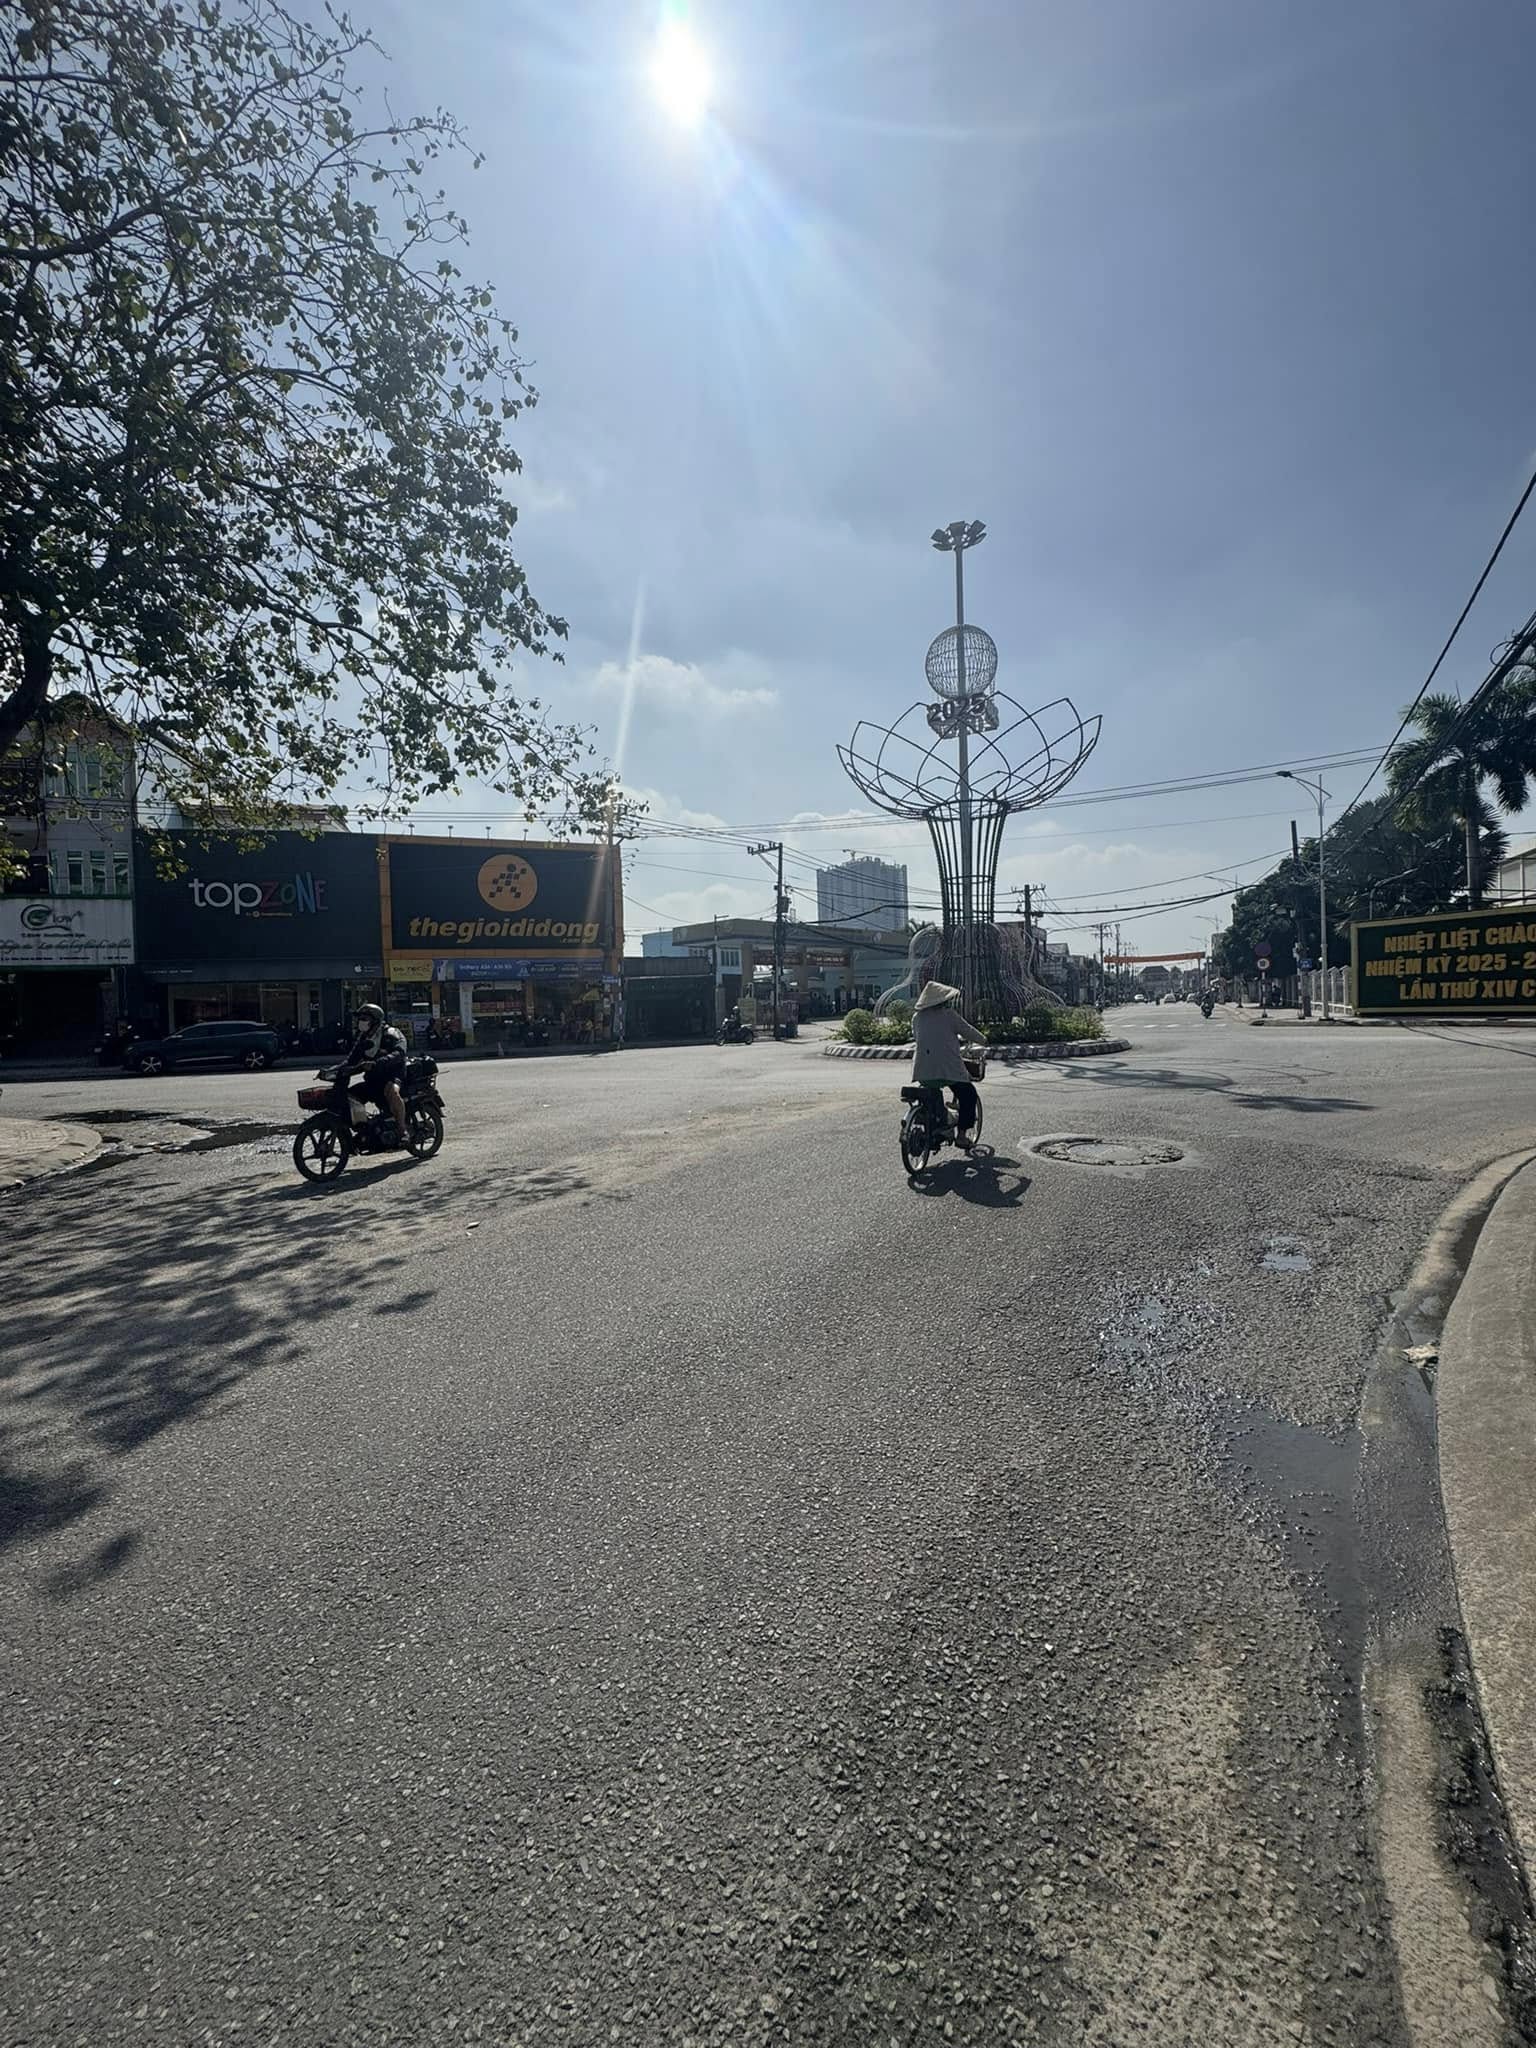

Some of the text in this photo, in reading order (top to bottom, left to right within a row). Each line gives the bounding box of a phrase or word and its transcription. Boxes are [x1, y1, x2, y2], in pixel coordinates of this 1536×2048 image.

[409, 917, 600, 944] thegioididong
[1384, 931, 1435, 953] NHIỆT
[1440, 927, 1480, 950] LIỆT
[1365, 956, 1422, 978] NHIỆM
[1427, 953, 1451, 974] KỲ
[1456, 954, 1507, 972] 2025
[1440, 978, 1479, 999] THỨ
[1482, 979, 1518, 999] XIV
